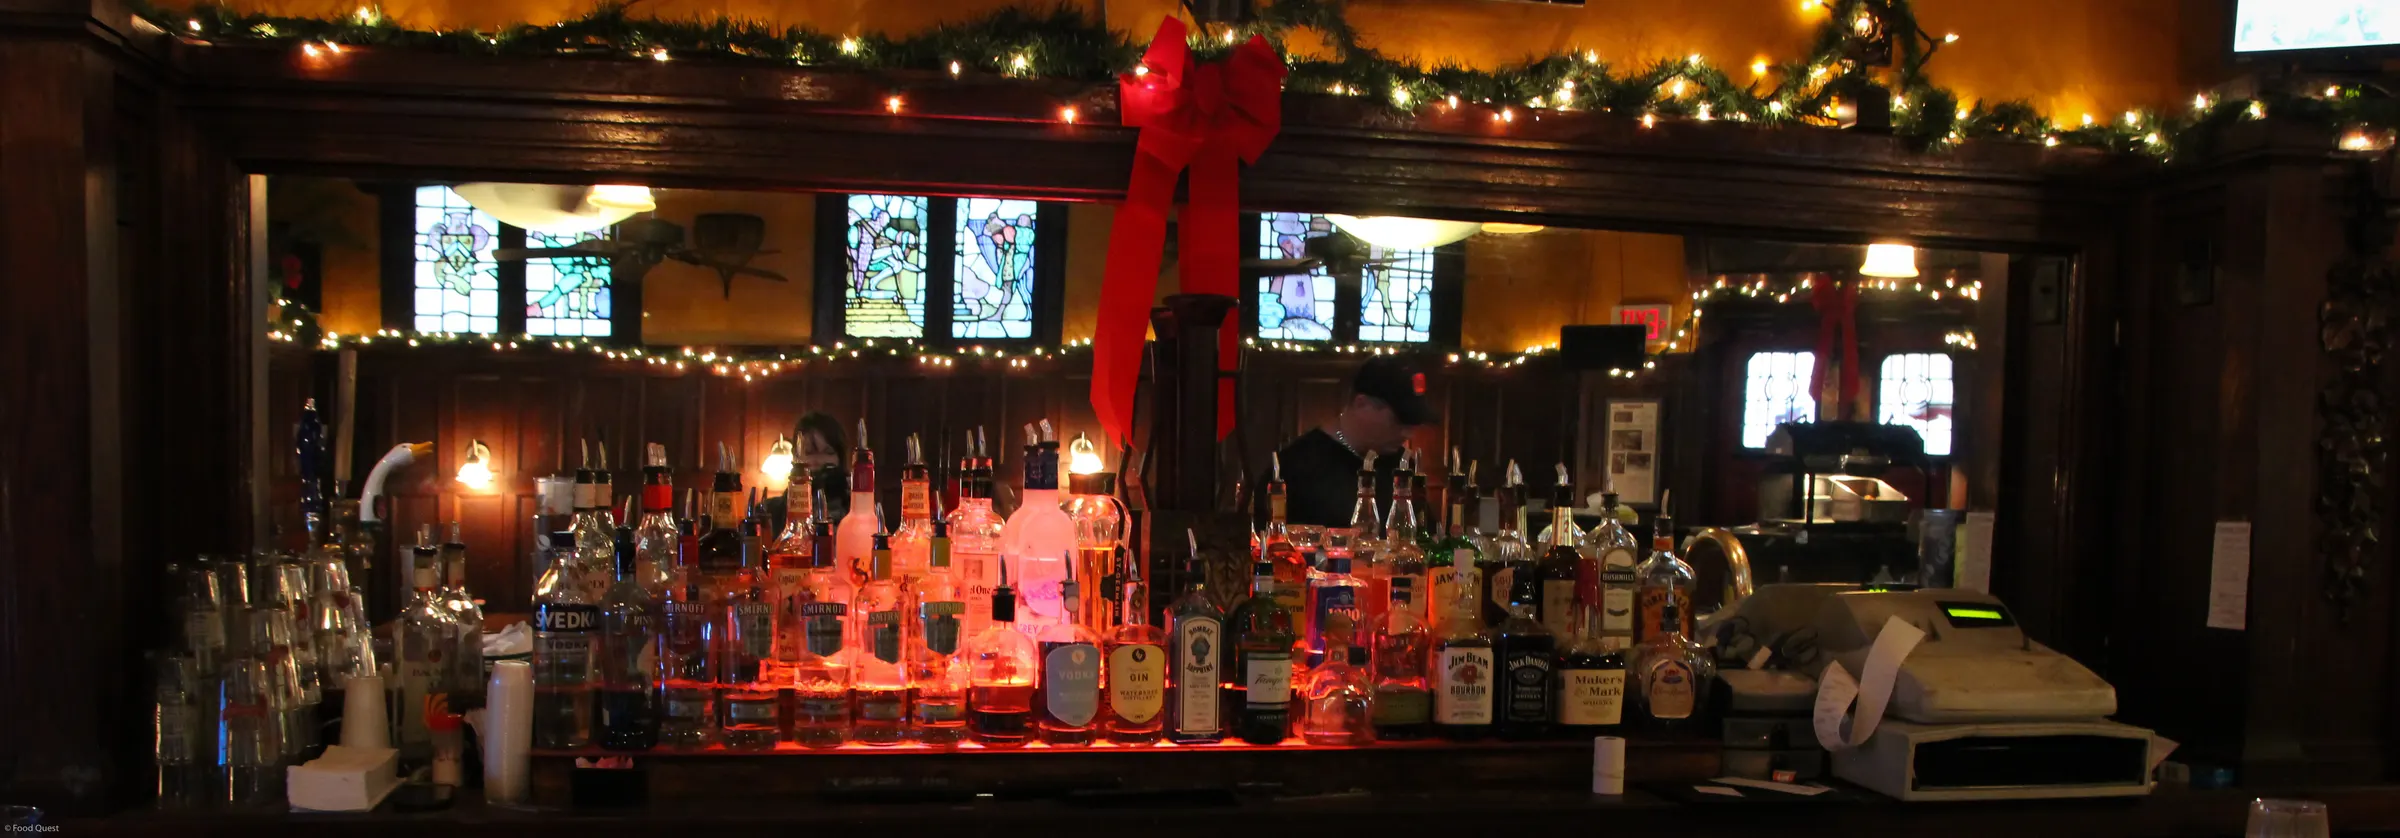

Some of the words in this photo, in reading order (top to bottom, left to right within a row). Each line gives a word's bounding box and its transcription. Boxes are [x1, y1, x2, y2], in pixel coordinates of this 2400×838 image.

[802, 603, 846, 614] SMIRNOFF
[535, 611, 595, 629] SVEDKA
[1448, 655, 1465, 670] JIM
[1466, 652, 1489, 669] BEAM
[1508, 659, 1525, 672] JACK
[1129, 673, 1149, 682] GIN
[1575, 675, 1623, 685] Maker's
[1450, 685, 1486, 695] BOURBON
[1589, 687, 1622, 697] Mark
